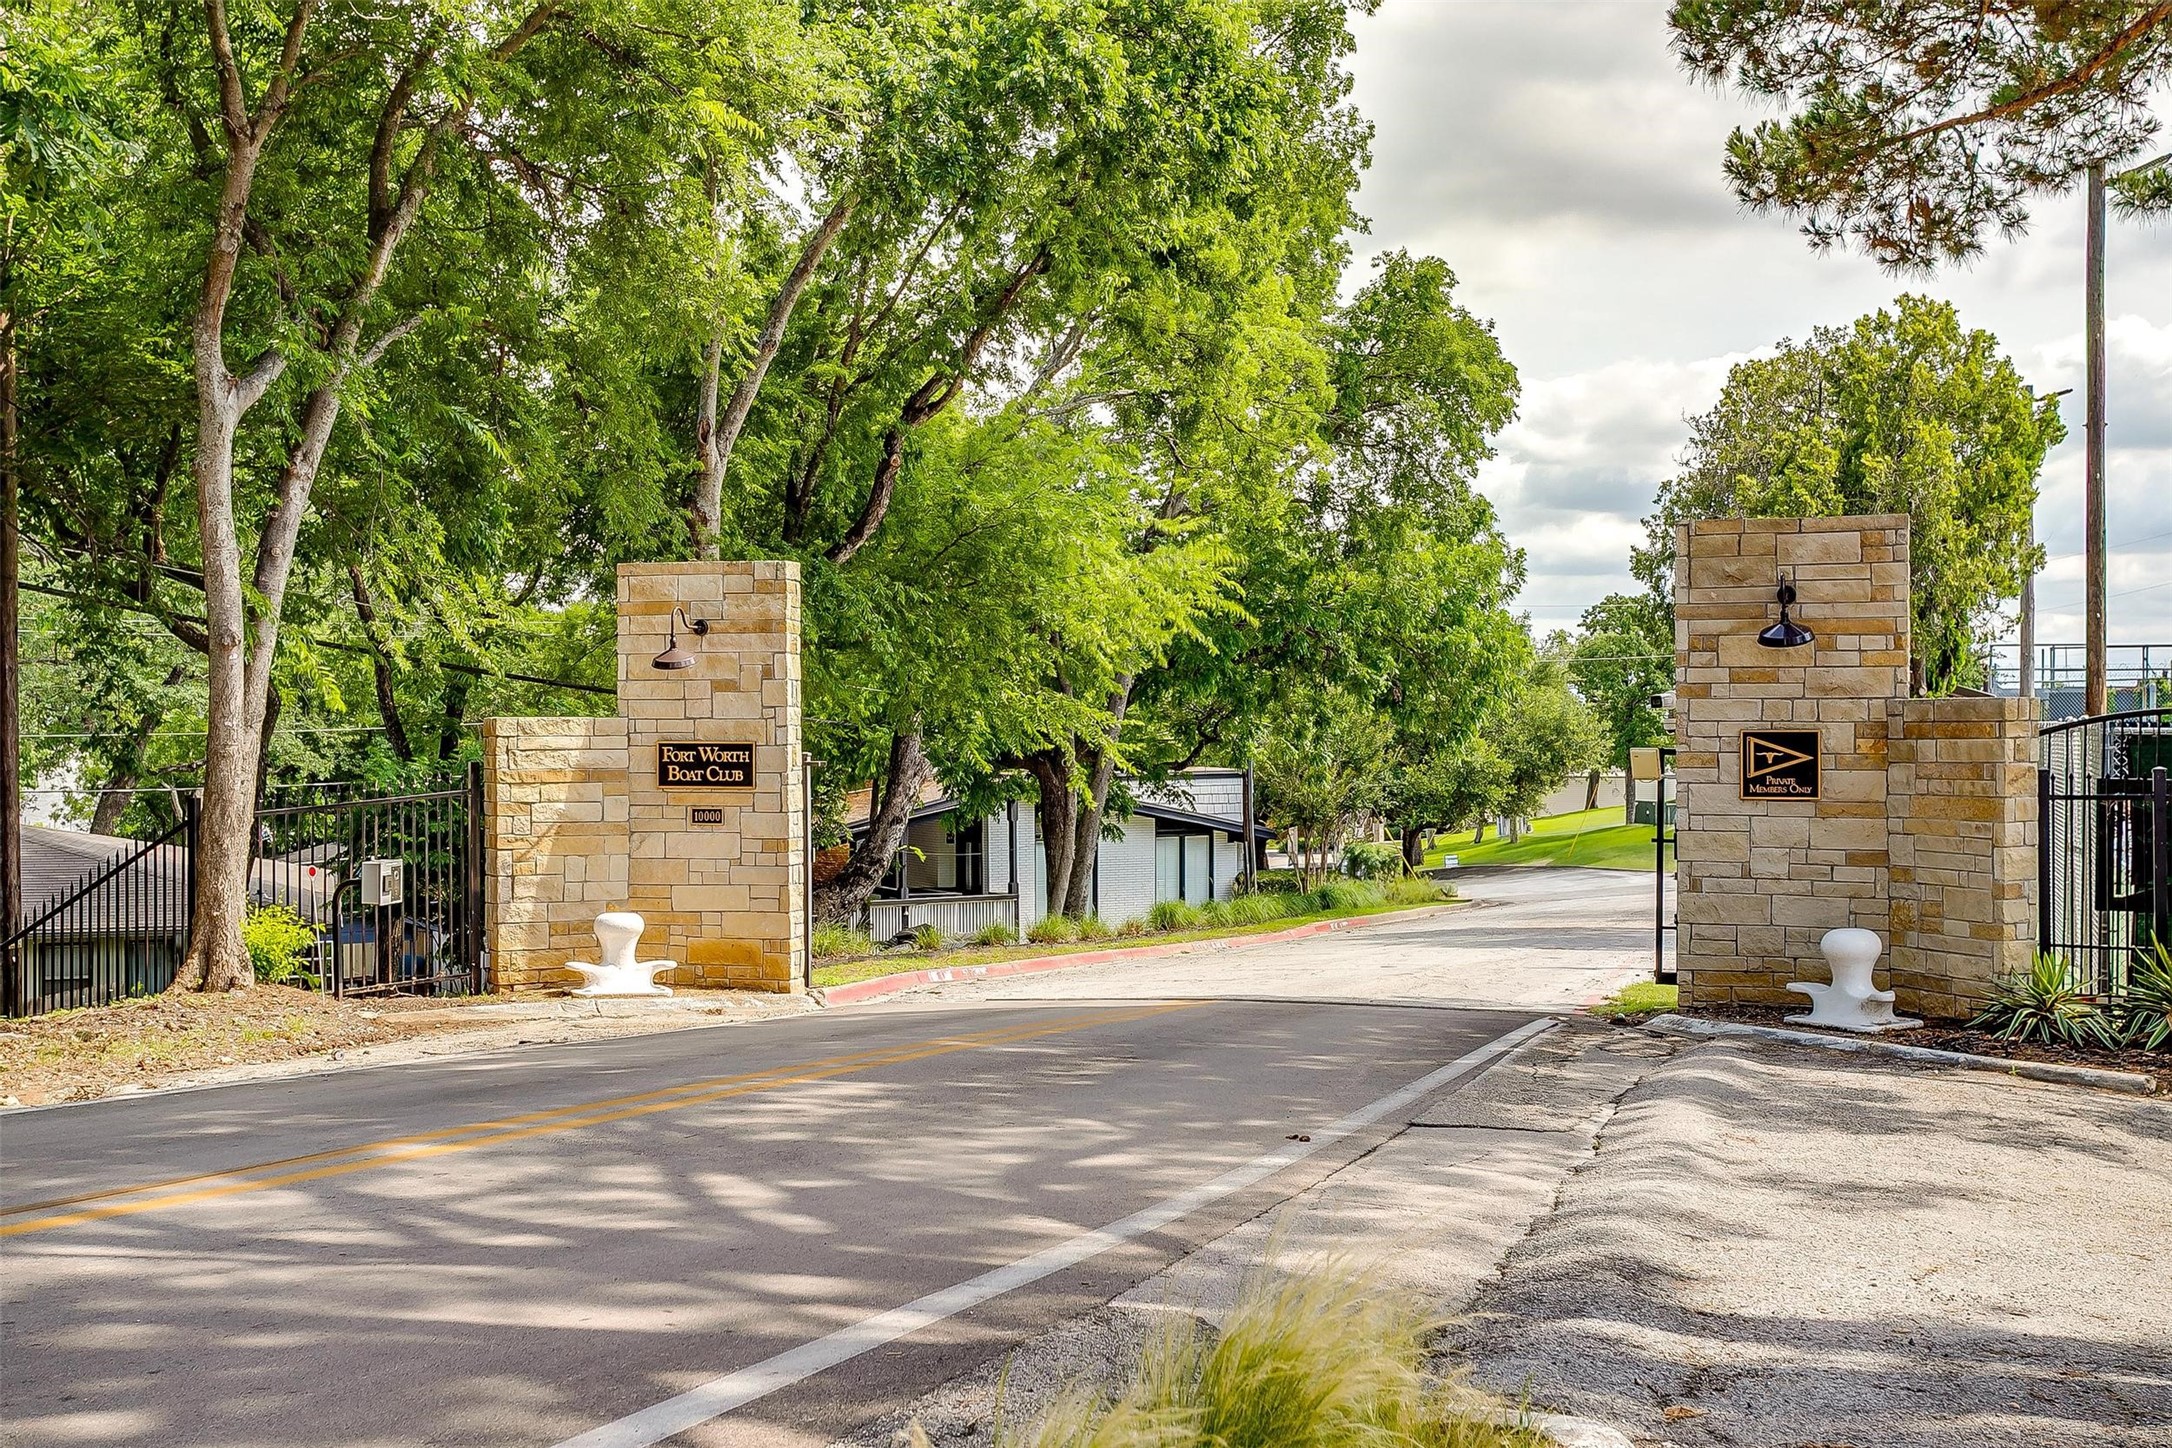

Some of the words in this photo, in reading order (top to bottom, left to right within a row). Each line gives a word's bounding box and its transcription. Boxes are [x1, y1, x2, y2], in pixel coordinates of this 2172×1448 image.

[662, 746, 696, 762] FORT
[698, 746, 750, 762] WORTH
[667, 765, 704, 781] BOAT
[706, 765, 744, 782] CLUB
[1766, 775, 1796, 785] PRIVATE
[1749, 784, 1788, 793] MEMBERS
[1789, 784, 1813, 794] ONLY
[694, 811, 721, 821] 10000
